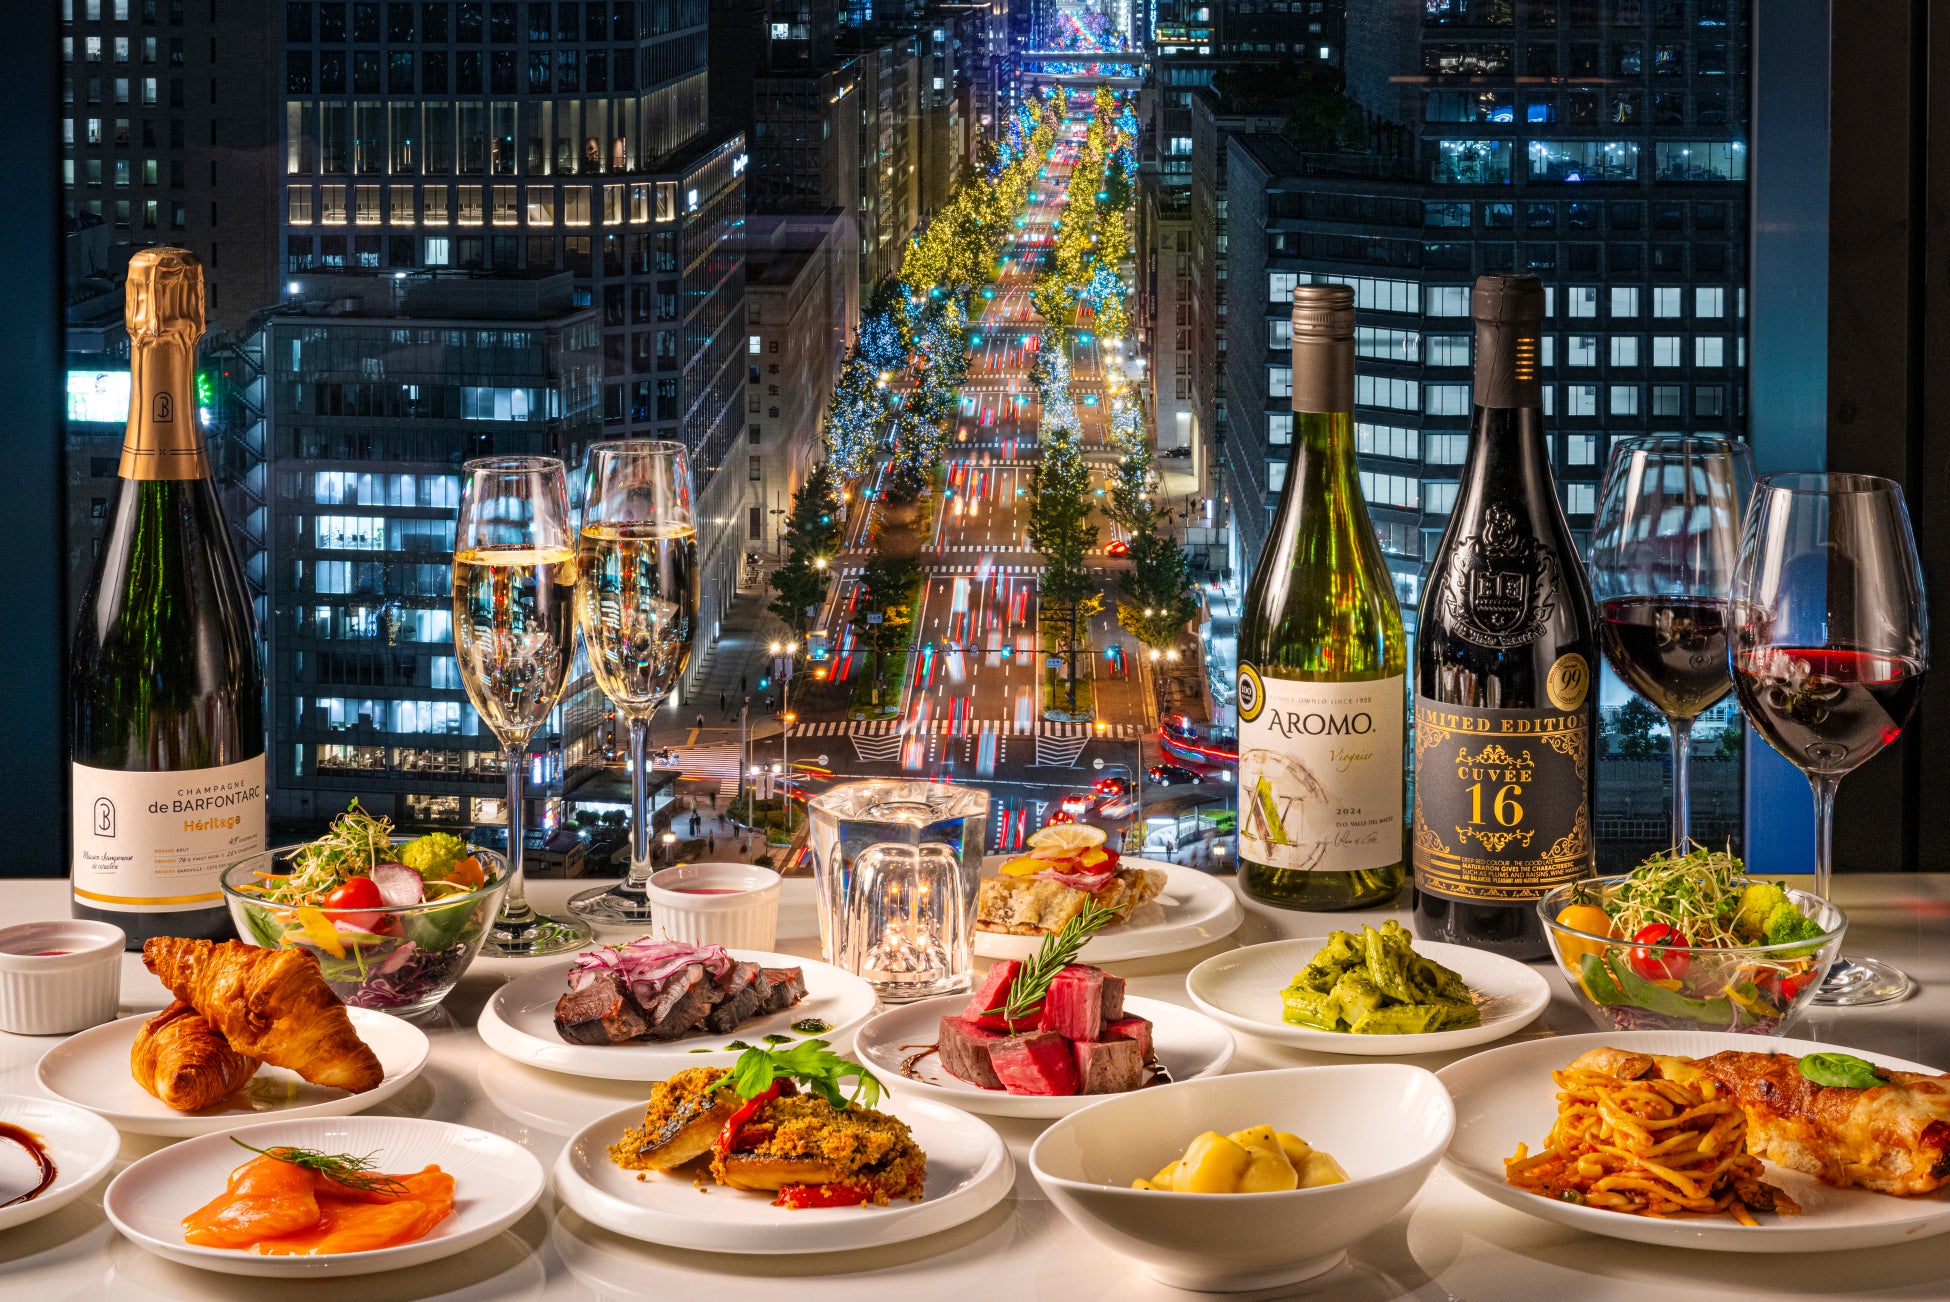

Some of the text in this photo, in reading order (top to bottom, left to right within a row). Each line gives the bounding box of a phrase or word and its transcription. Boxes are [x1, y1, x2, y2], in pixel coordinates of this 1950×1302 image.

[768, 341, 779, 418] 日本生命
[1560, 669, 1582, 691] 99
[1415, 704, 1587, 733] LIMITED EDITION
[1457, 765, 1532, 782] CUVÉE
[148, 785, 260, 814] de BARFONTARC
[177, 780, 246, 797] CHAMPAGNE
[1465, 782, 1524, 827] 16
[183, 815, 241, 833] Héritage
[1462, 863, 1500, 871] MATURATION
